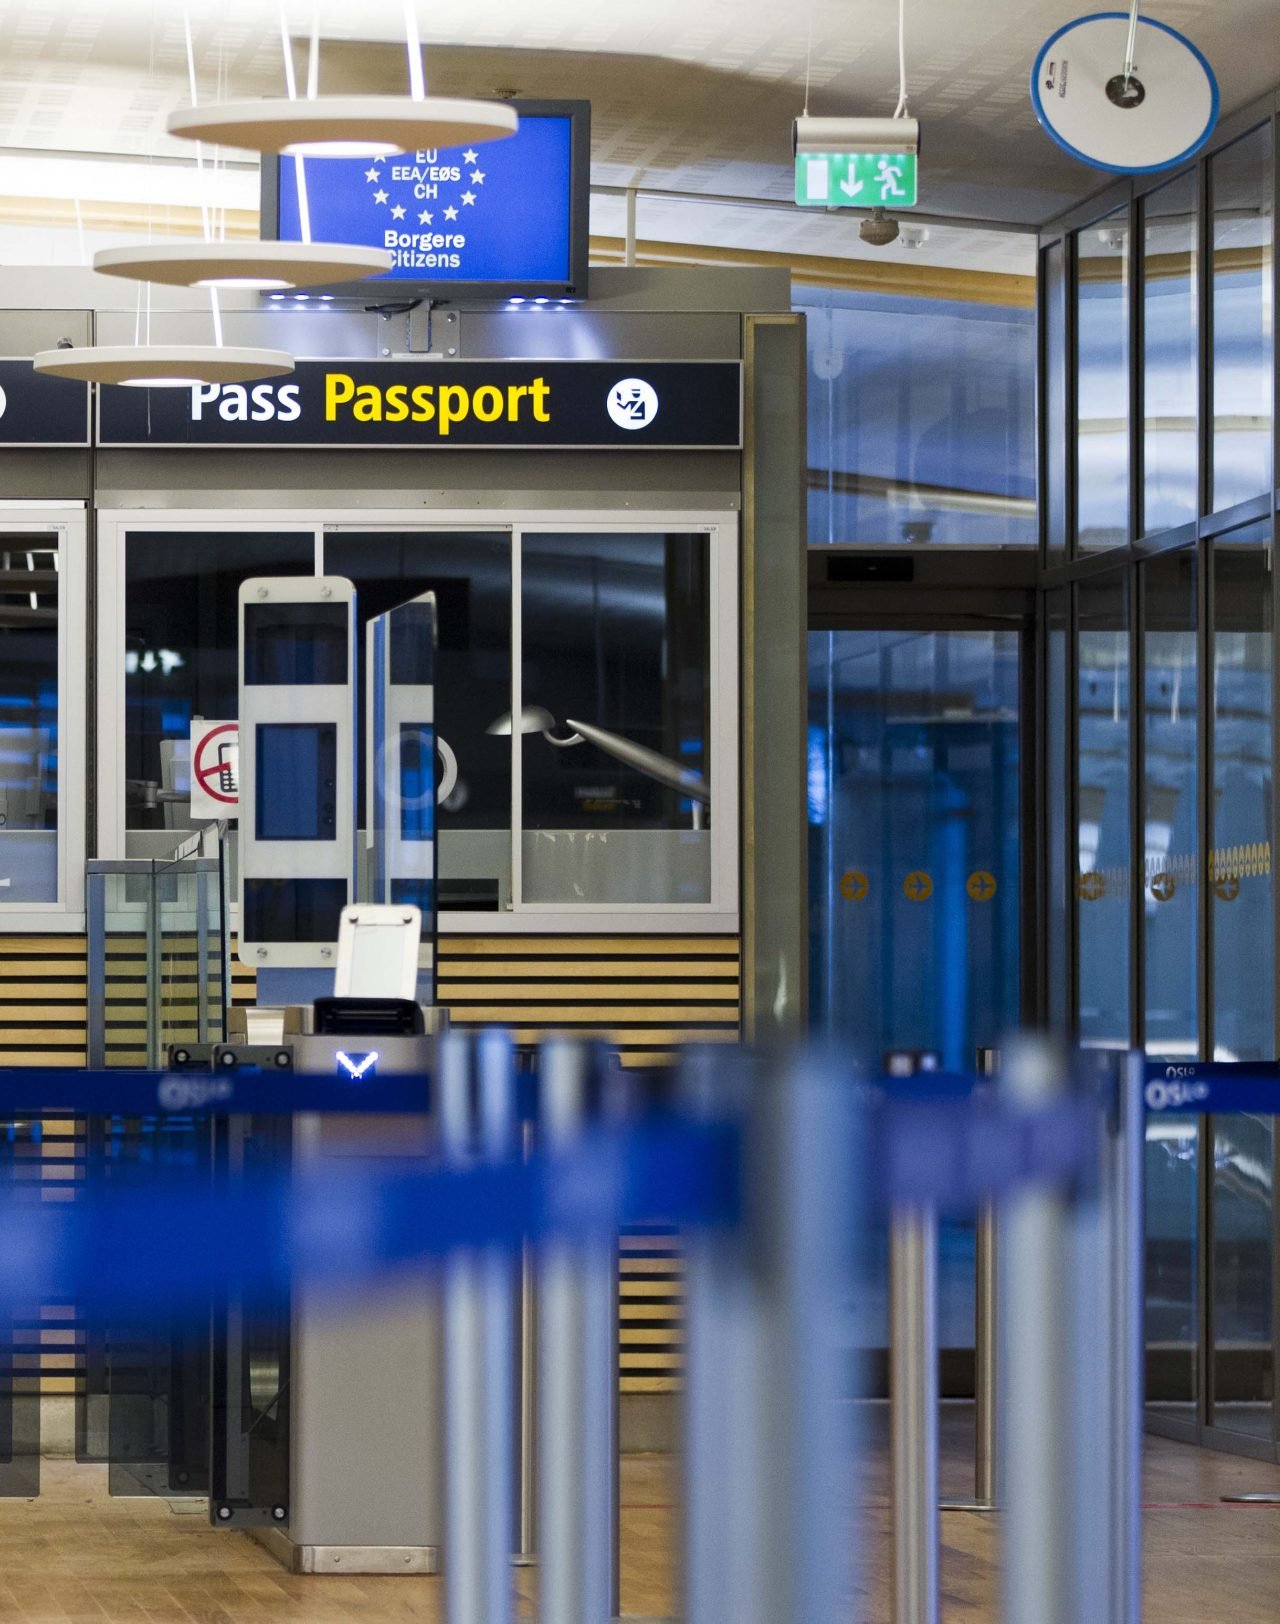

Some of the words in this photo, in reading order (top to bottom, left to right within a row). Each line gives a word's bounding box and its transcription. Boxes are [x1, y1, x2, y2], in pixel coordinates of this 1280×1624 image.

[415, 148, 438, 164] EU
[391, 166, 461, 183] EEA/EØS
[413, 183, 438, 199] CH
[384, 229, 466, 252] Borgere
[191, 383, 301, 422] Pass
[325, 373, 550, 436] Passport
